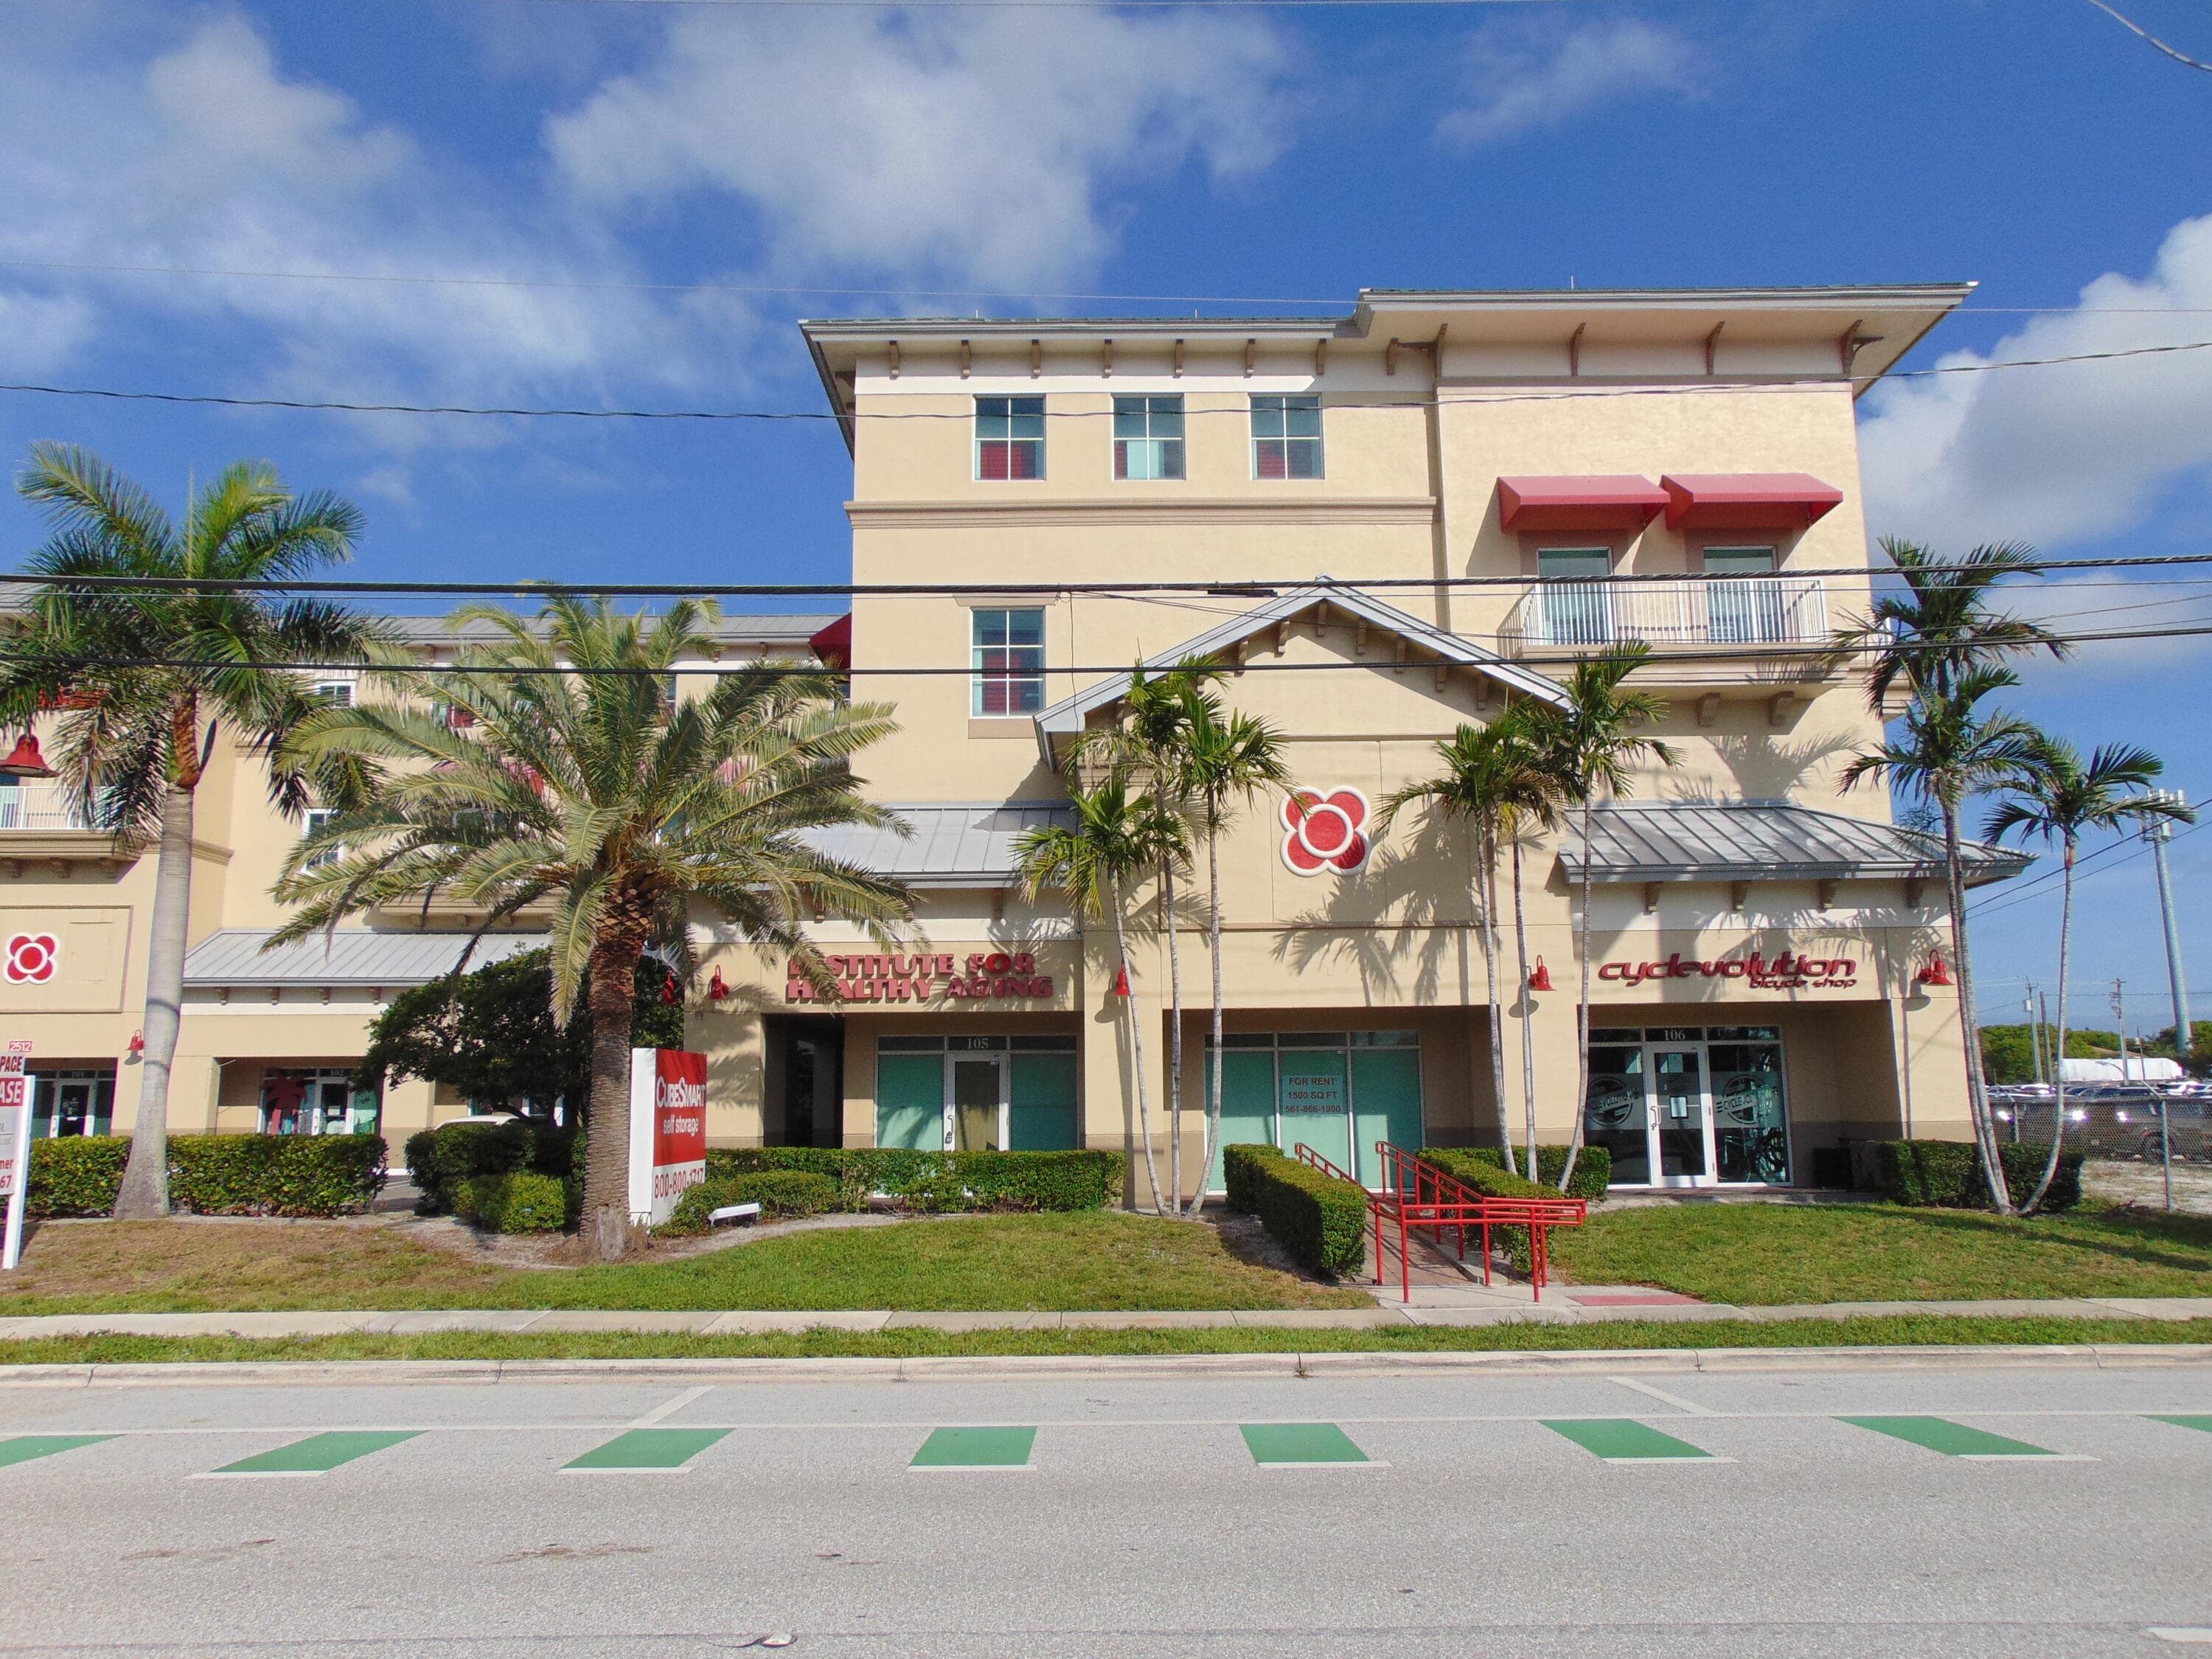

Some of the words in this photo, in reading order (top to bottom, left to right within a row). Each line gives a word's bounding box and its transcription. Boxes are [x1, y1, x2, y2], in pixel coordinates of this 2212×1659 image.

[969, 953, 1035, 975] FOR
[1599, 951, 1857, 987] cyclevolution
[787, 977, 934, 1000] HALTHY
[945, 976, 1053, 999] AGING
[1749, 975, 1808, 991] bicycle
[1812, 978, 1857, 990] shop
[1664, 1029, 1686, 1041] 106
[10, 1042, 32, 1052] 2512
[967, 1037, 988, 1049] 105
[1289, 1077, 1309, 1085] FOR
[1311, 1077, 1336, 1085] RENT
[1288, 1091, 1308, 1099] 1500
[1310, 1091, 1324, 1099] SQ
[1326, 1091, 1338, 1099] FT
[1285, 1105, 1341, 1113] 561-866-1900
[663, 1114, 675, 1134] self
[675, 1115, 699, 1137] storage
